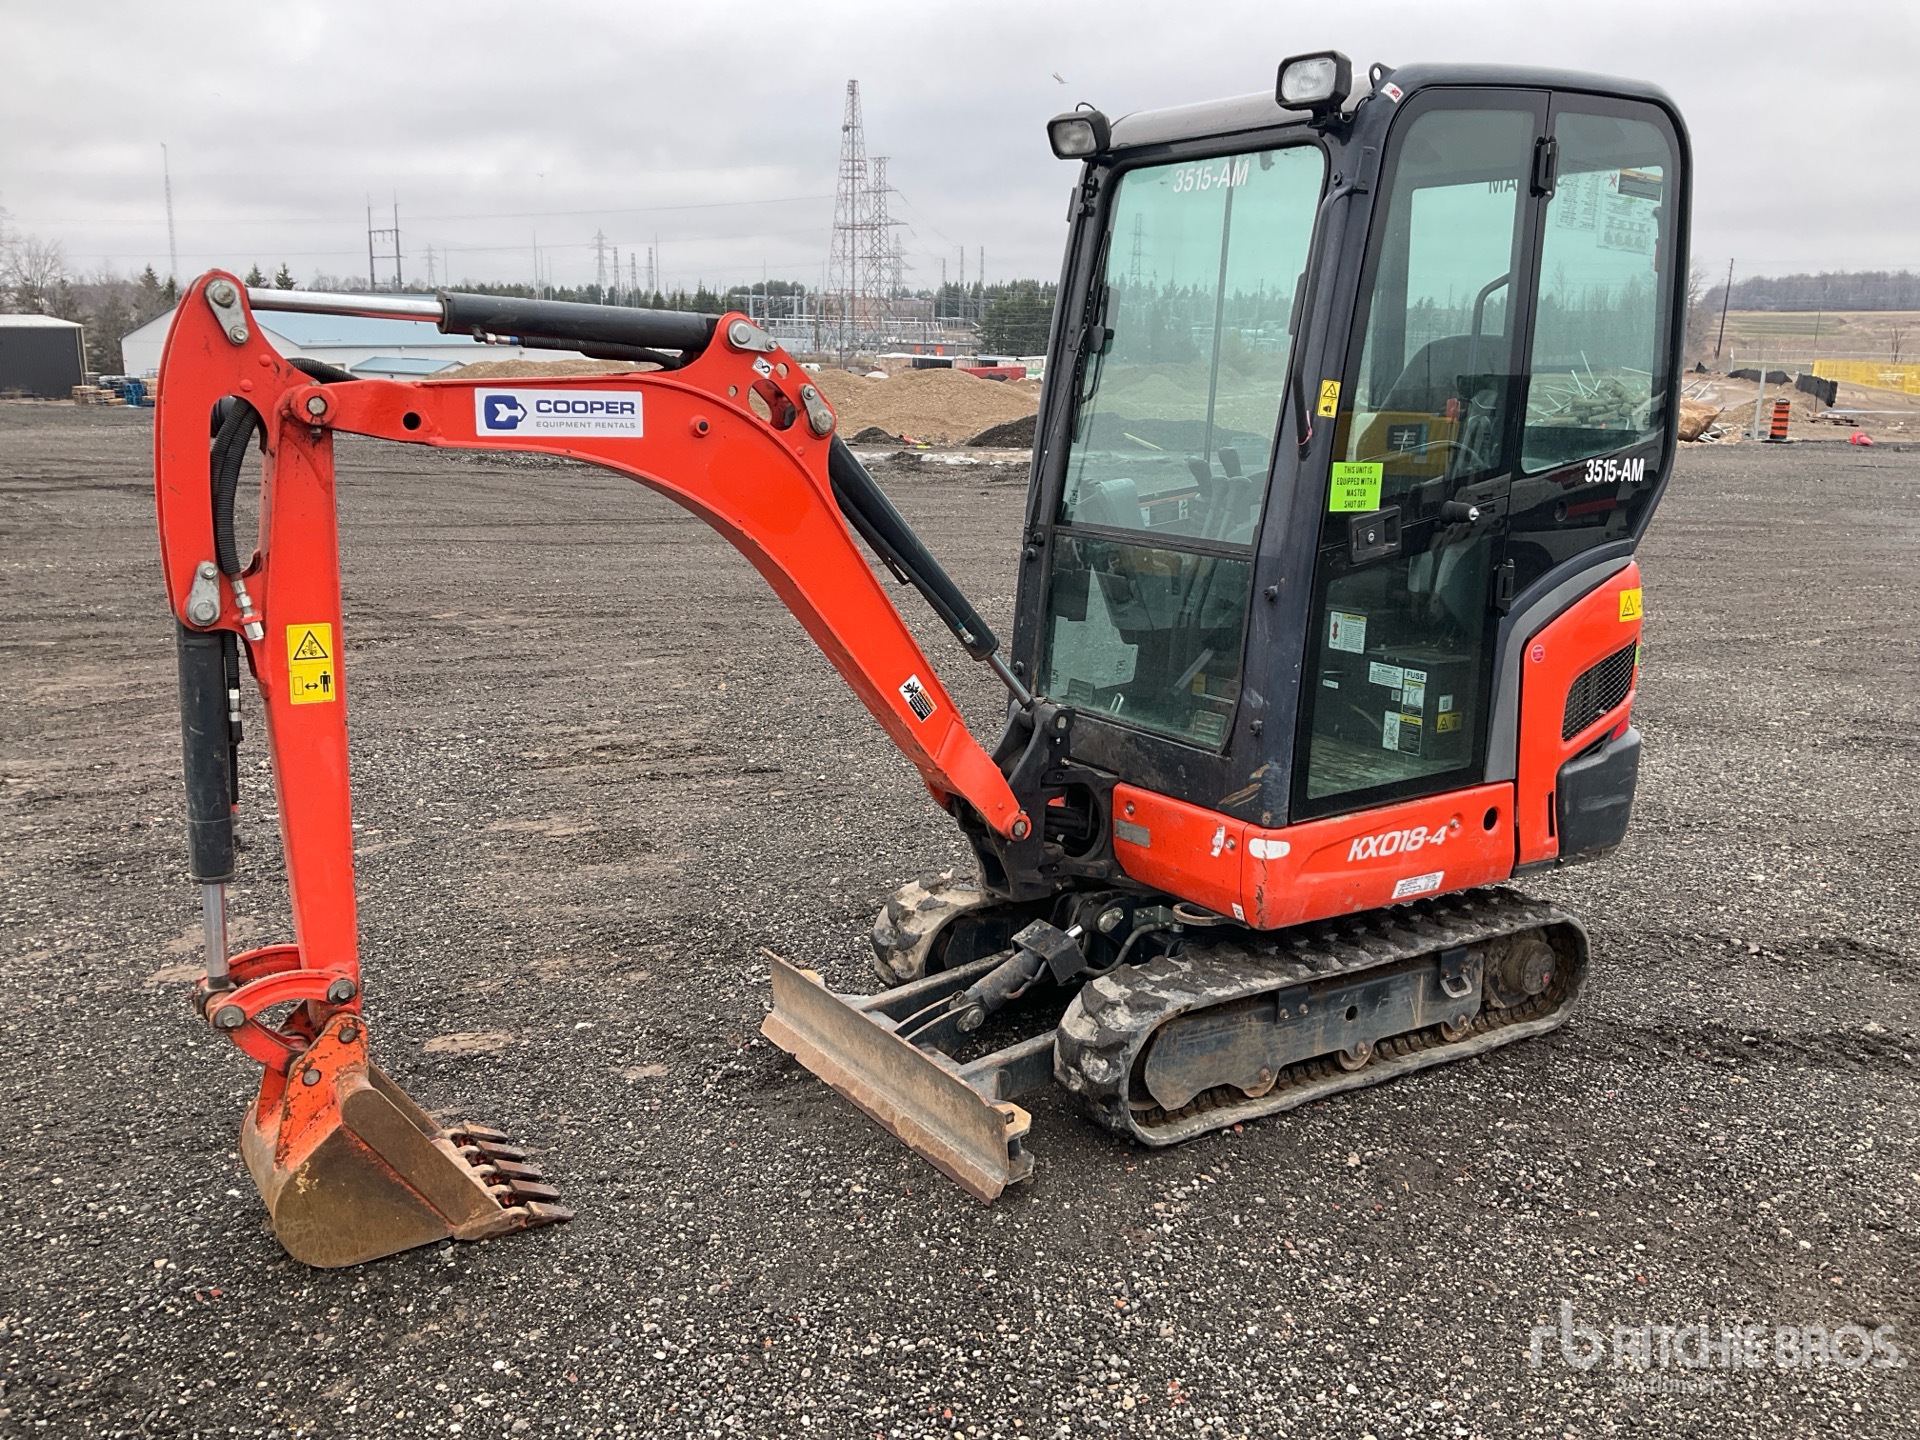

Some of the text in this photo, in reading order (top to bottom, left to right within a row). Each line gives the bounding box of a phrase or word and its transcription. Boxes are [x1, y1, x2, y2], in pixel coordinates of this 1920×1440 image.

[1173, 160, 1250, 193] 3515-AM
[535, 399, 635, 415] COOPER
[1344, 466, 1355, 474] THIS
[1355, 466, 1367, 474] UNIT
[1585, 458, 1645, 482] 3515-AM
[1336, 477, 1360, 485] EQUIPPED
[1360, 477, 1373, 486] WITH
[1346, 489, 1367, 497] MASTER
[1344, 500, 1367, 508] SHUT OFF
[1406, 670, 1425, 681] FUSE
[1346, 825, 1448, 862] KX018-4
